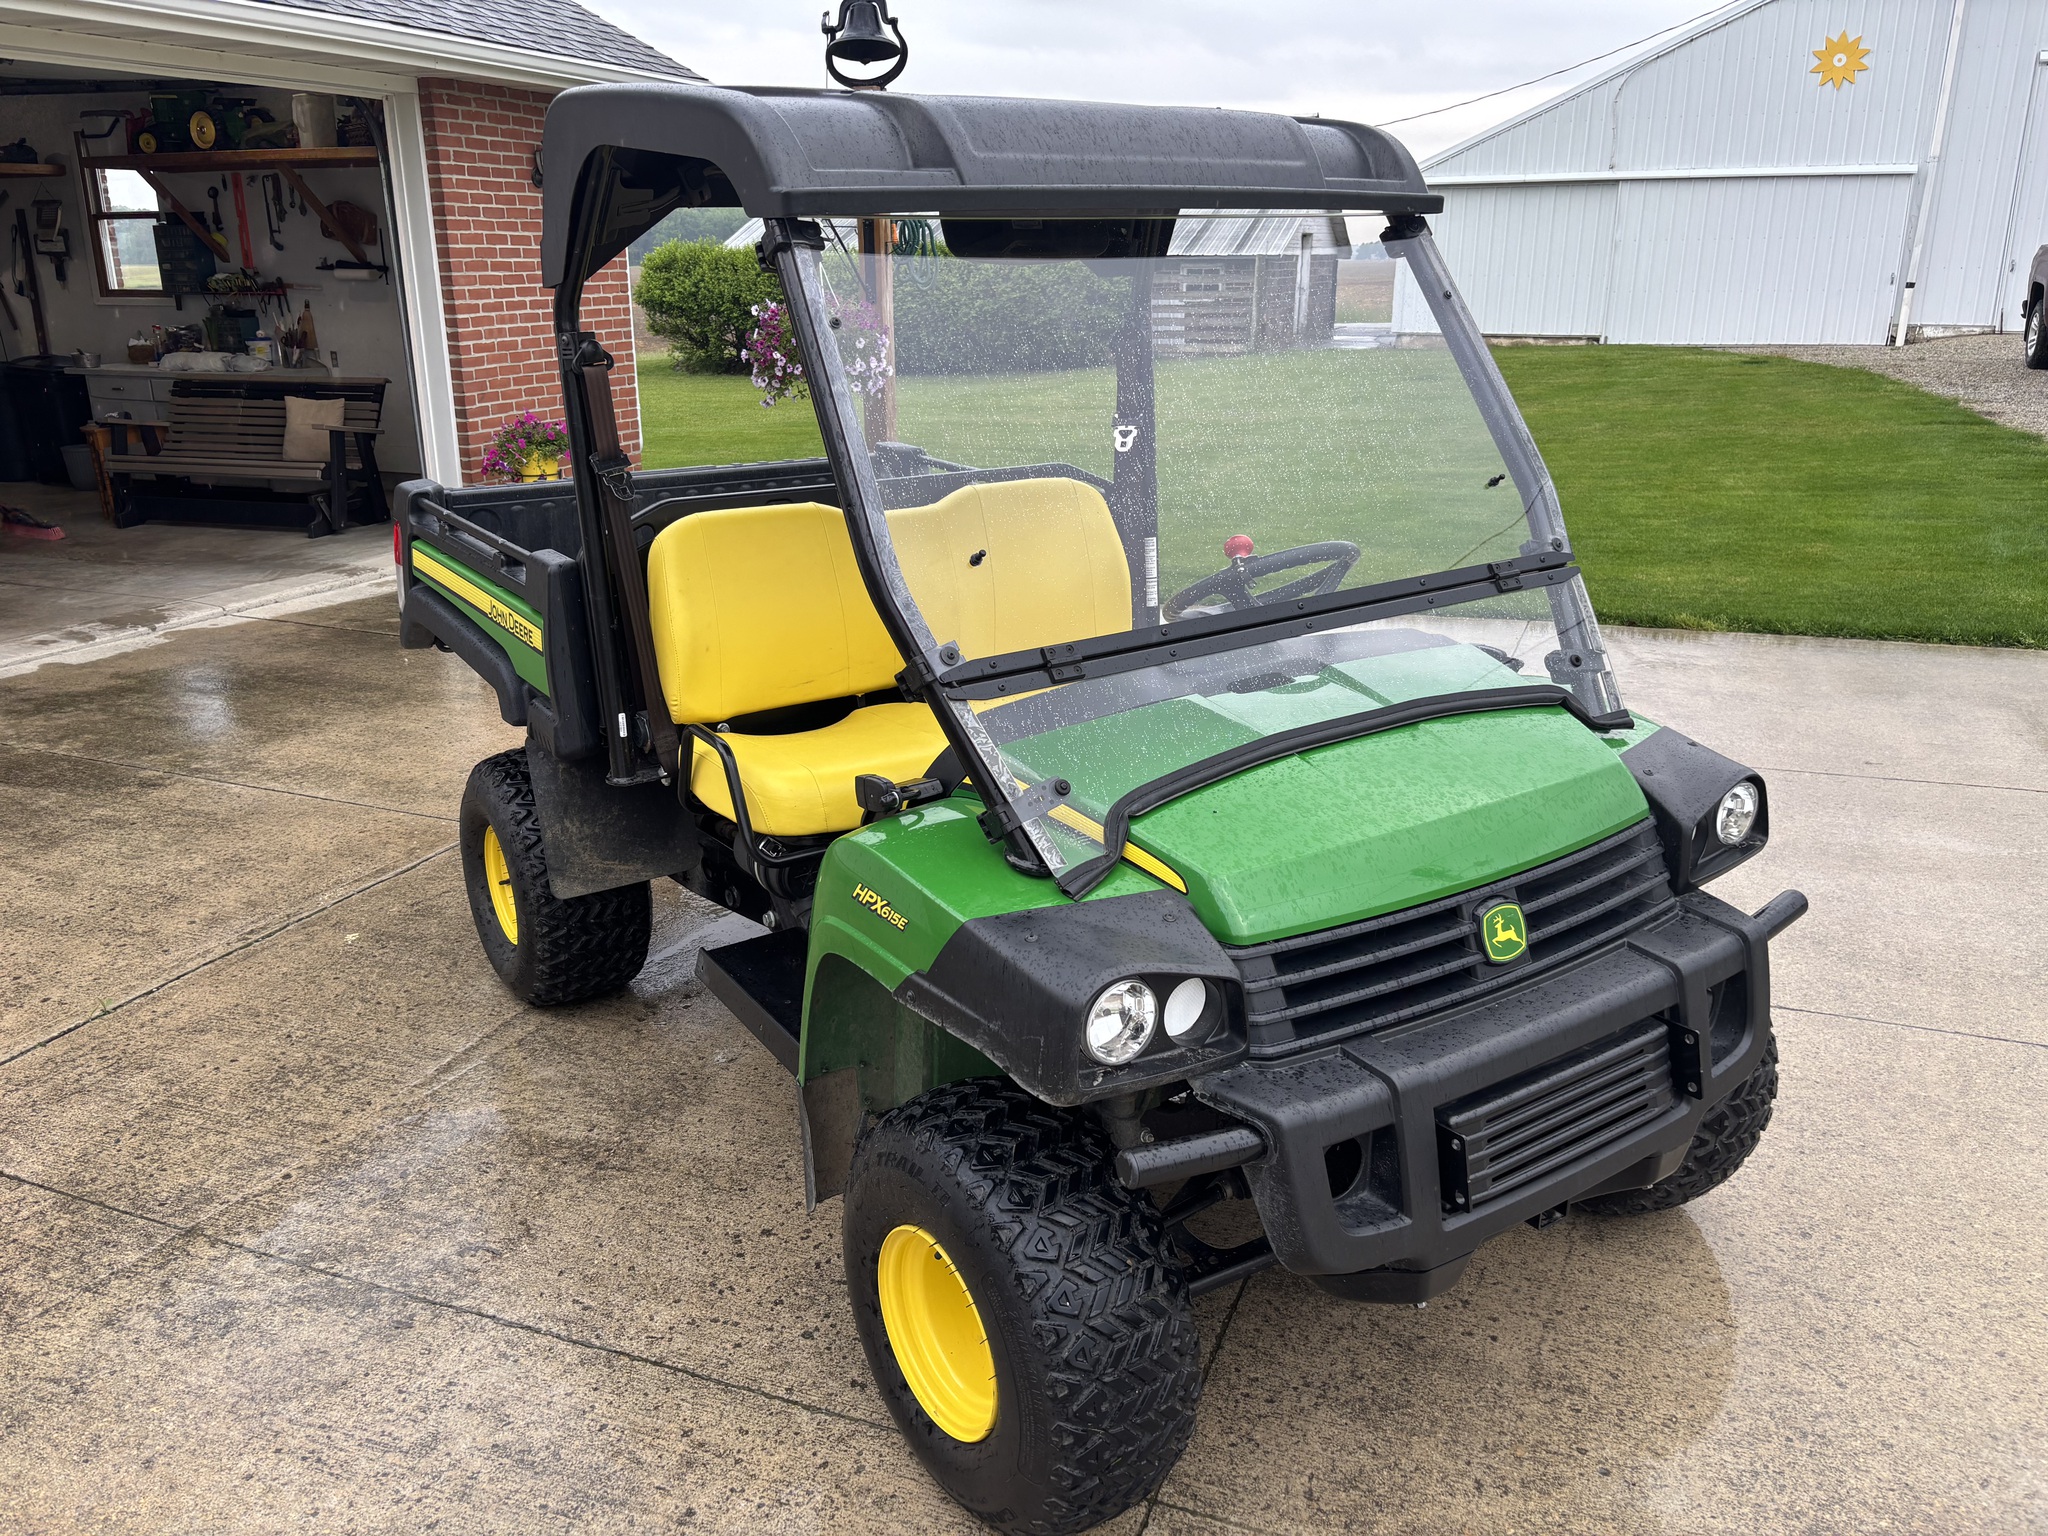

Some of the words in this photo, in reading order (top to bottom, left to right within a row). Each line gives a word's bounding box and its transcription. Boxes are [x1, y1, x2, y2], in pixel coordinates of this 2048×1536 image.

[488, 600, 508, 627] JOHN
[509, 613, 534, 645] DEERE
[852, 882, 909, 931] HPX615E
[877, 1151, 926, 1186] TRAIL
